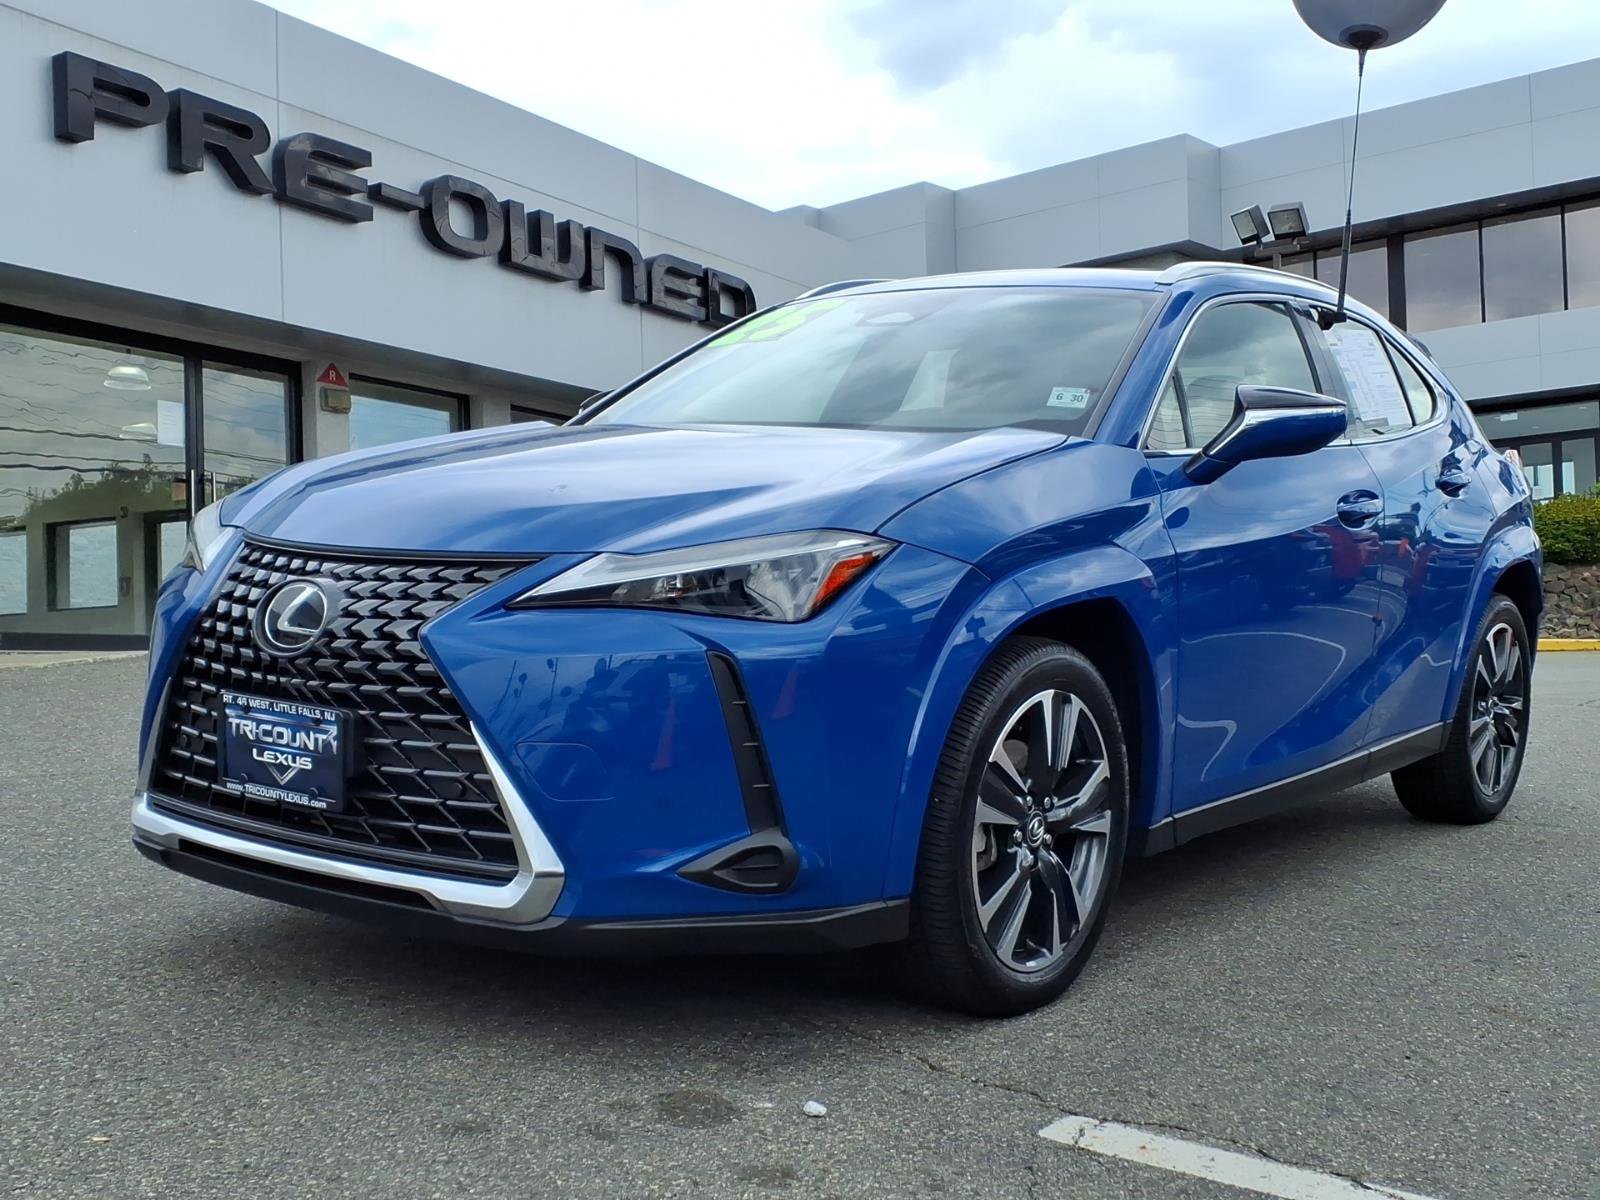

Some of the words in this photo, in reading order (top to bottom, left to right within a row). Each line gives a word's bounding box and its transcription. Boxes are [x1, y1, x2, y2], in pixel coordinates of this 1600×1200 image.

[51, 50, 757, 327] PRE-OWNED
[1070, 393, 1084, 402] 30
[273, 702, 297, 715] LITTLE
[297, 706, 323, 720] FALLS,
[324, 711, 336, 721] NJ
[252, 748, 312, 770] LEXUS
[226, 781, 327, 809] www.TRICOUNTYLEXUS.com
